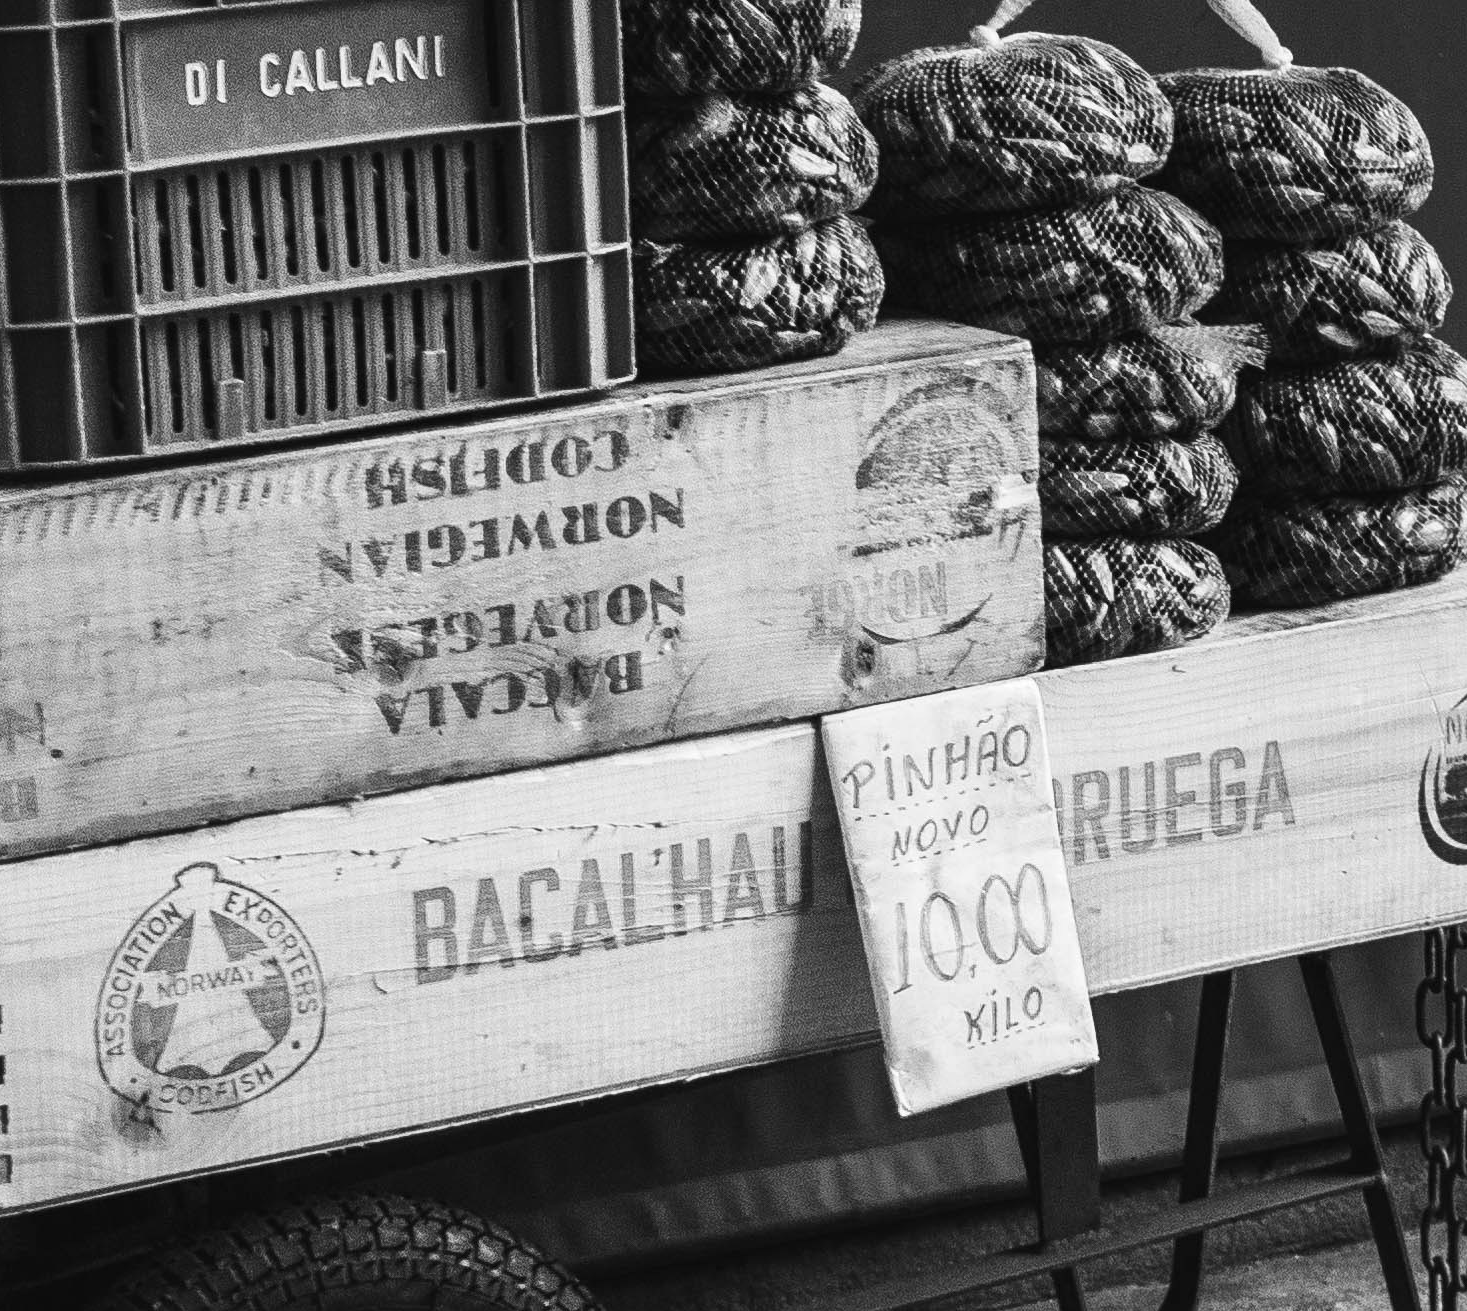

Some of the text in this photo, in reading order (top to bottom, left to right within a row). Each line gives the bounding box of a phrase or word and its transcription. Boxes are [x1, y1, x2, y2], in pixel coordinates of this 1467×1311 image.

[184, 35, 445, 106] DI CALLANI
[364, 430, 631, 510] CODFISH
[317, 487, 686, 584] NORWEGIAN
[842, 714, 1032, 809] PINHÃO
[891, 804, 989, 861] NOVO
[412, 820, 814, 987] BACALHAU
[104, 901, 186, 1057] ASSOCIATION
[223, 890, 319, 1015] EXPORTERS
[963, 986, 1043, 1044] KILO
[158, 1061, 276, 1106] CODFISH
